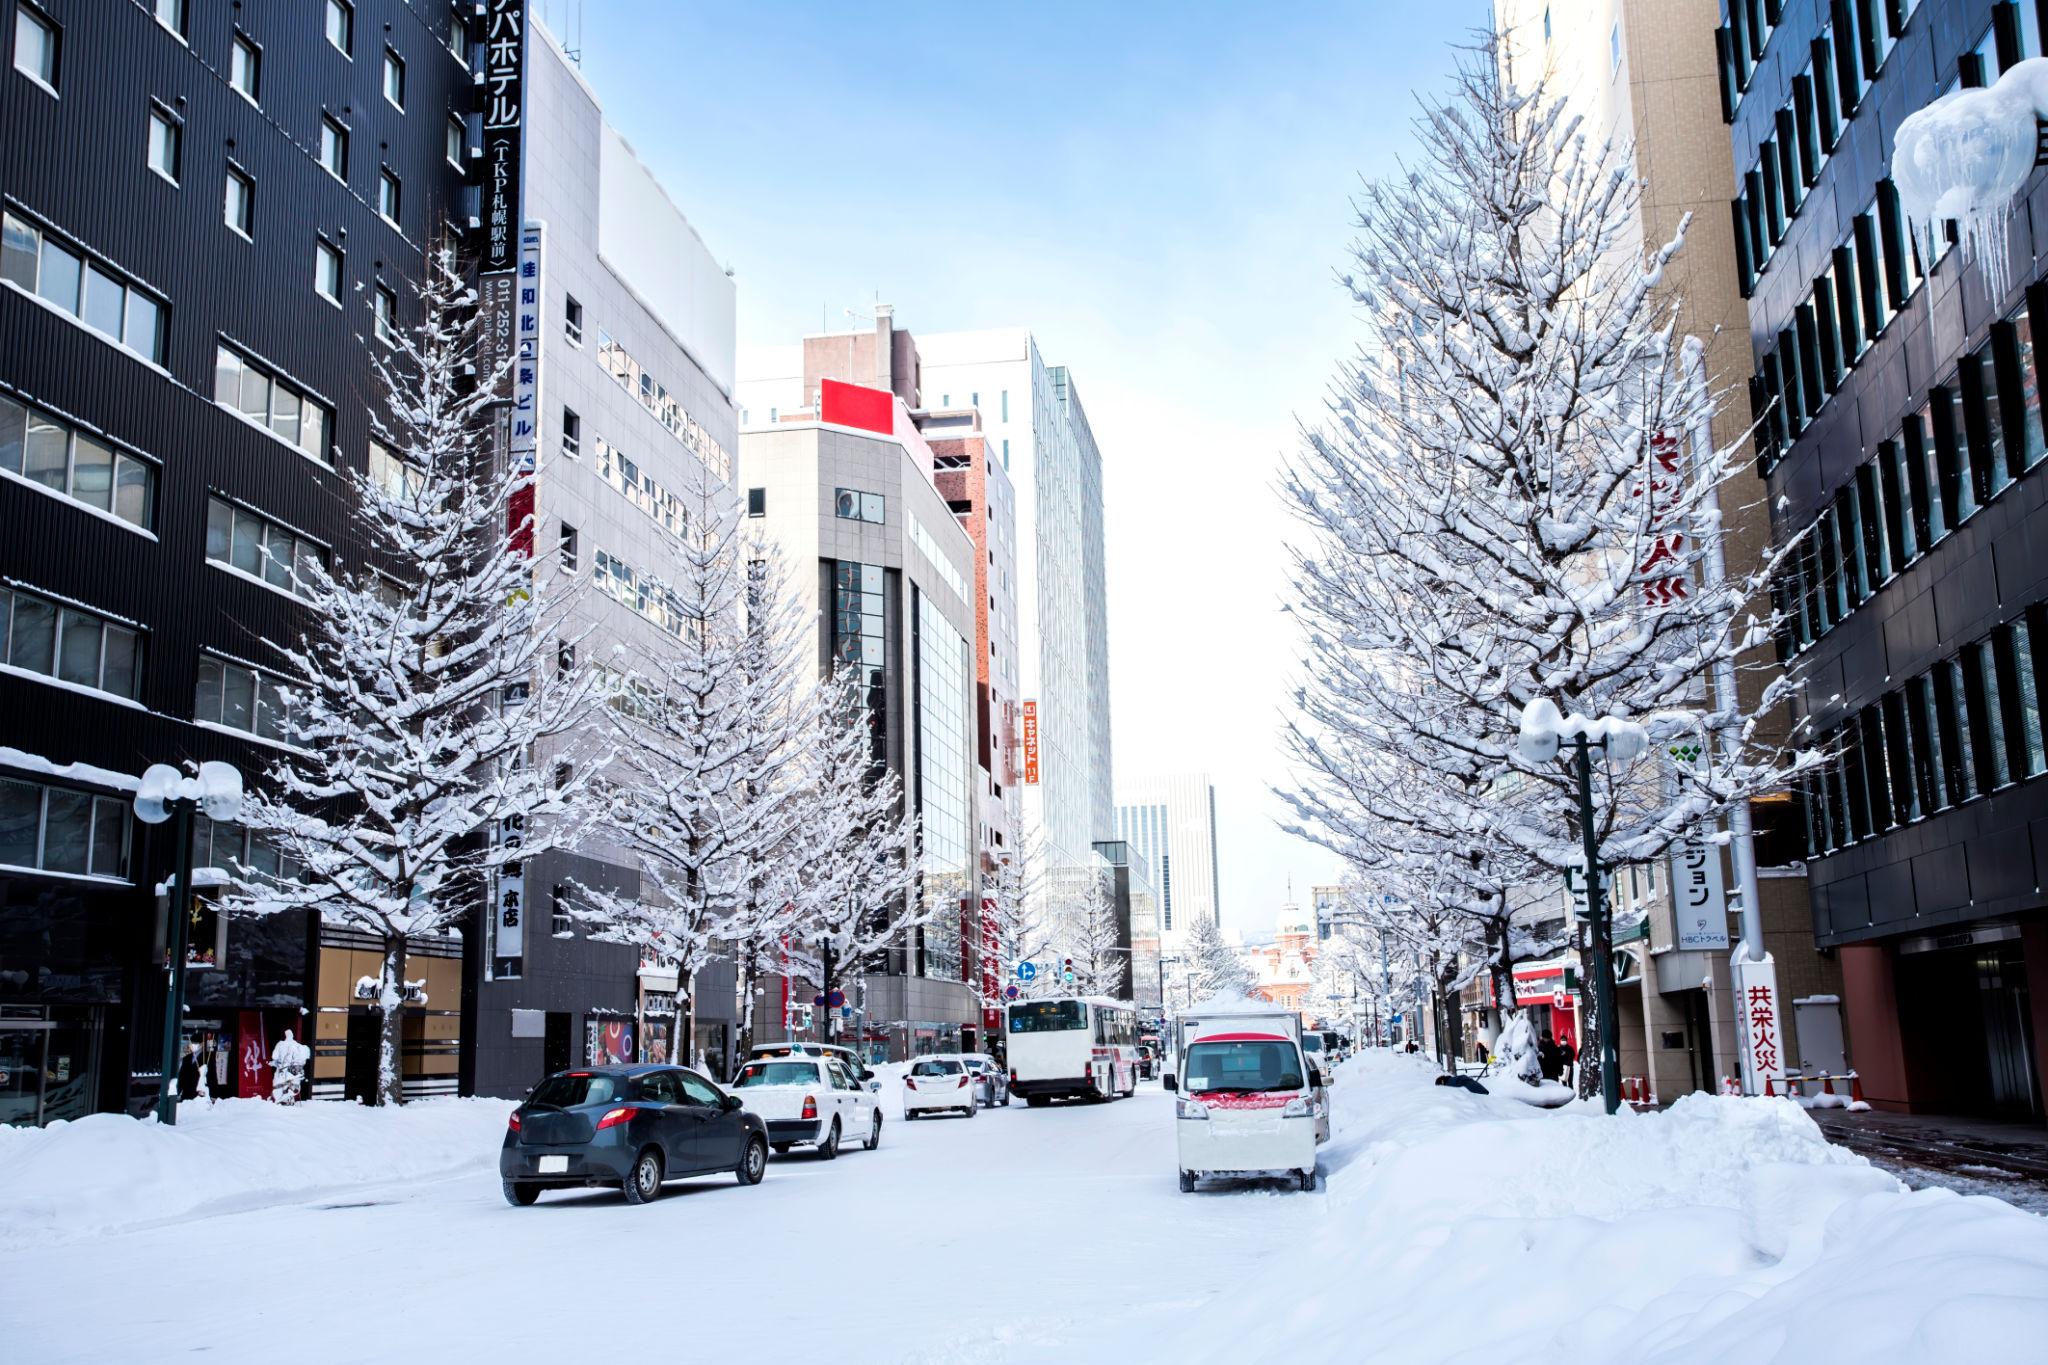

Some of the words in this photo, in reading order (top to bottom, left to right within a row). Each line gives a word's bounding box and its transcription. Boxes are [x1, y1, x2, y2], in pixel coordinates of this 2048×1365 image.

[504, 961, 512, 978] 1
[1748, 986, 1778, 1071] 共栄火災
